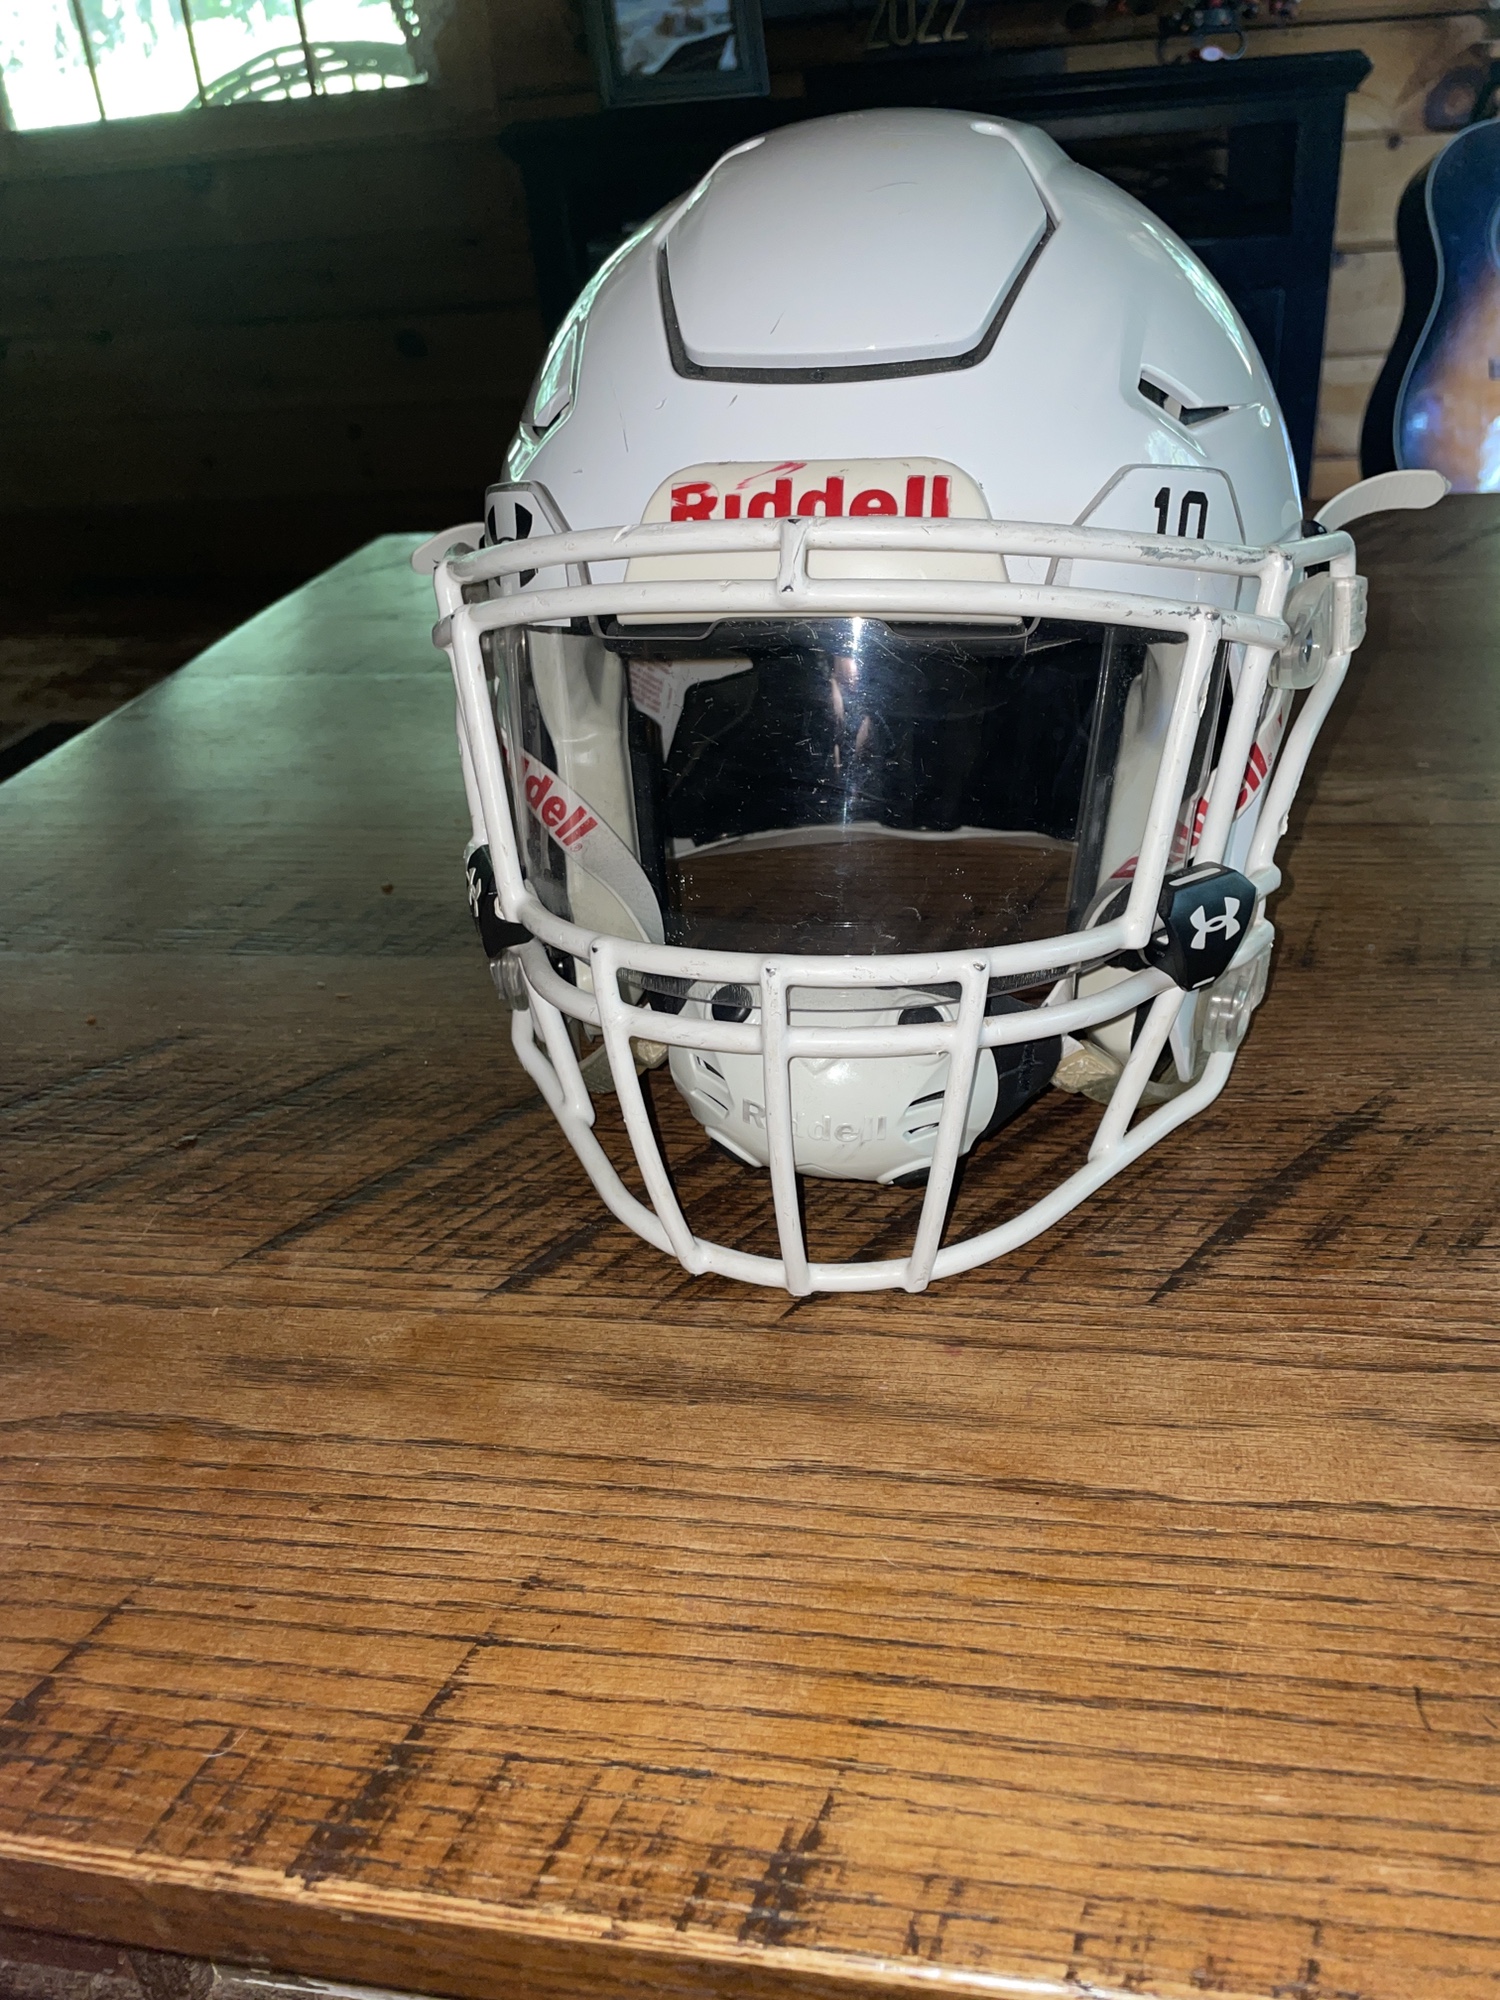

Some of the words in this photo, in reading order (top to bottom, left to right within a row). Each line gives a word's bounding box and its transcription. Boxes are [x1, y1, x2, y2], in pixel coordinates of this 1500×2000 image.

[671, 475, 951, 522] Riddell
[1154, 487, 1208, 539] 10
[518, 753, 598, 847] dell
